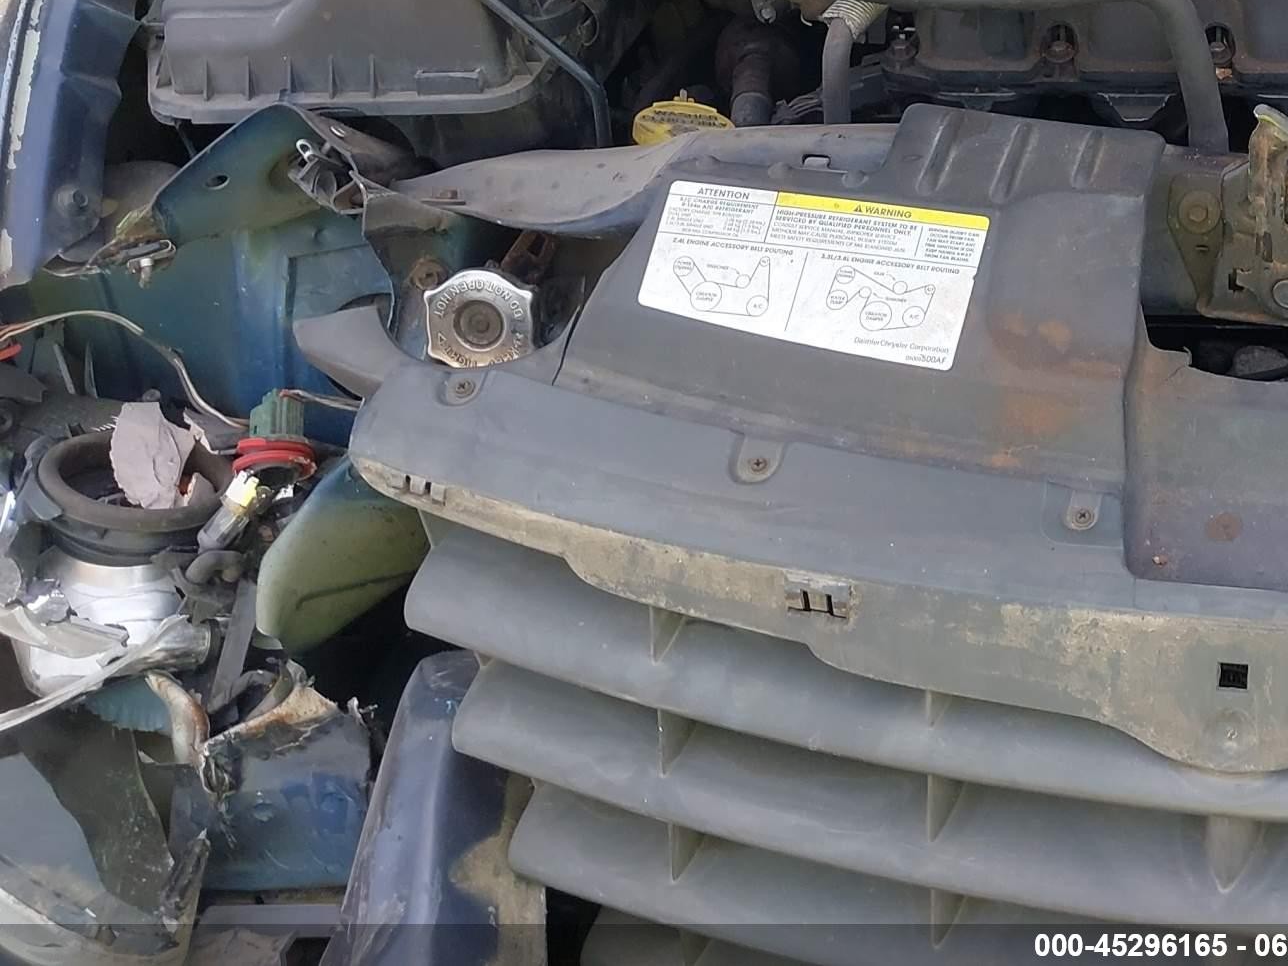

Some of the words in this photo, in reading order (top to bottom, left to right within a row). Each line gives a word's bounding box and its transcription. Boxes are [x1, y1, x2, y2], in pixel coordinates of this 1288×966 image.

[697, 188, 750, 199] ATTENTION
[777, 210, 826, 219] HIGH-PRESSURE
[828, 215, 871, 224] REFRIGERANT
[866, 206, 911, 218] WARNING
[819, 220, 852, 228] QUALIFIED
[854, 224, 890, 233] PERSONNEL
[711, 241, 749, 250] ACCESSORY
[765, 247, 793, 255] ROUTING
[876, 260, 915, 269] ACCESSORY
[931, 266, 959, 274] ROUTING
[450, 280, 485, 296] OPEN
[487, 281, 512, 301] NOT
[434, 294, 451, 317] HOT
[510, 300, 523, 319] DO
[854, 337, 907, 349] DaimlerChrysler
[910, 343, 949, 353] Corporation
